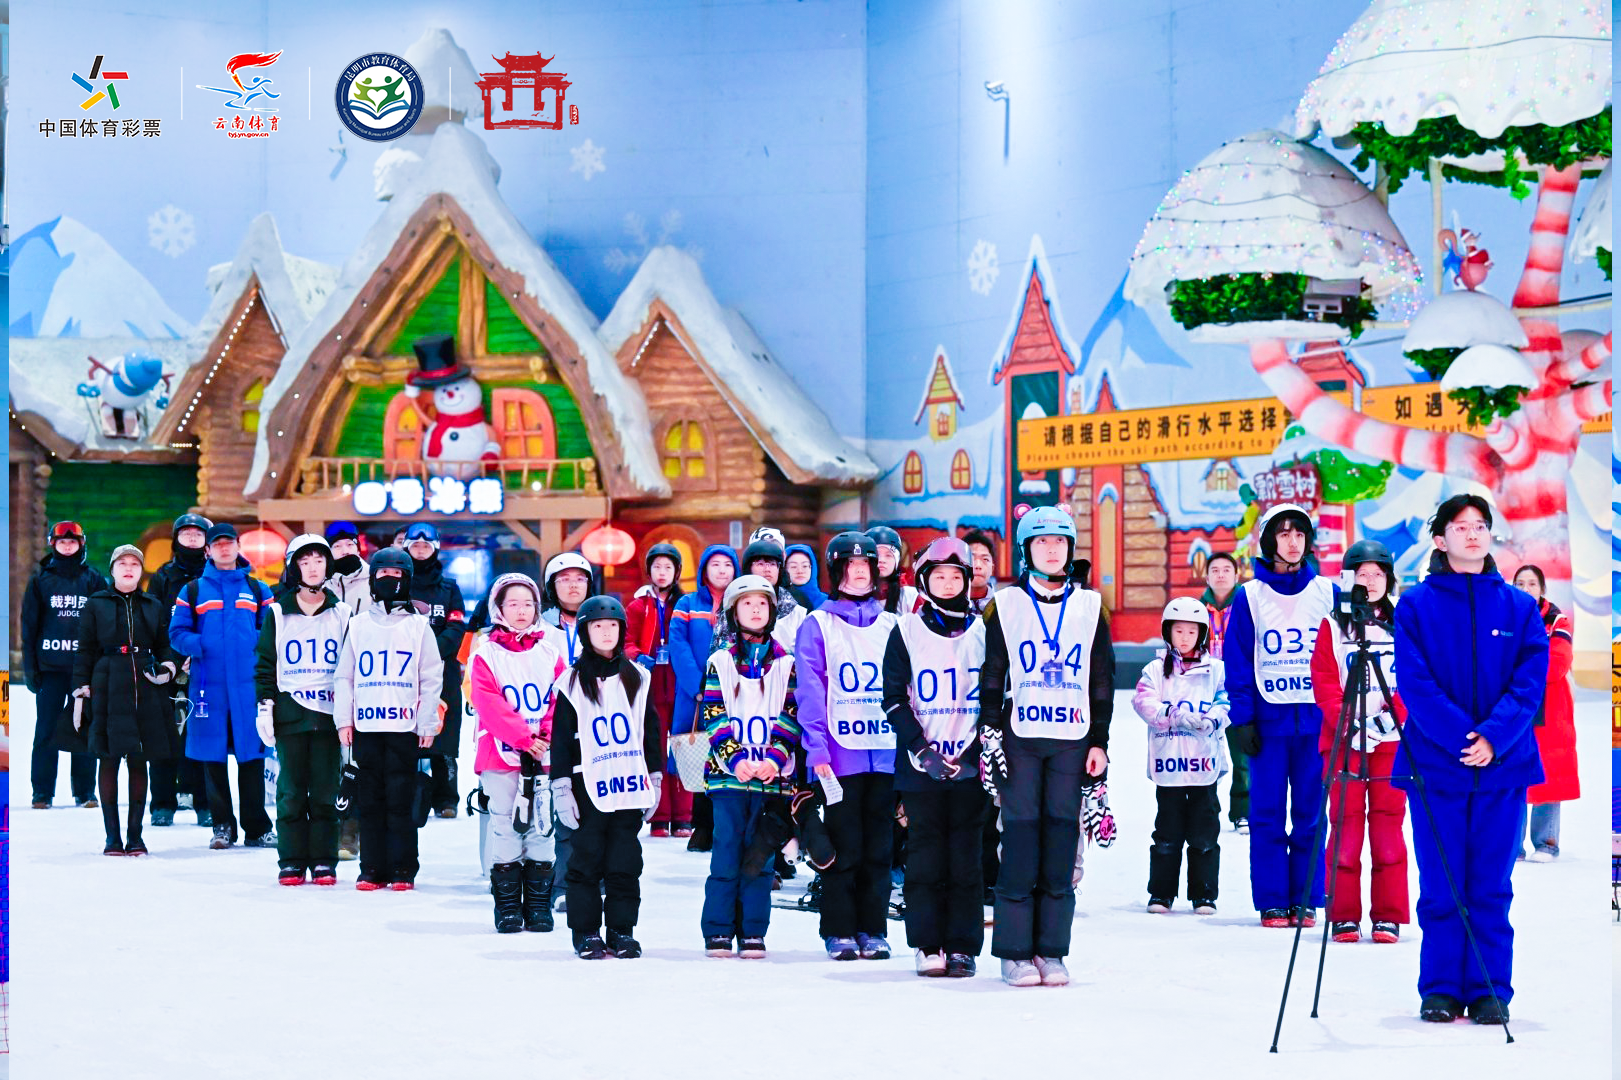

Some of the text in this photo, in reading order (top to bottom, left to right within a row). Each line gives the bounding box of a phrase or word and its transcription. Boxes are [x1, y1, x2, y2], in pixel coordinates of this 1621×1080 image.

[50, 594, 88, 609] 裁判员
[285, 638, 338, 665] 018
[358, 650, 413, 677] 017
[917, 667, 981, 702] 012
